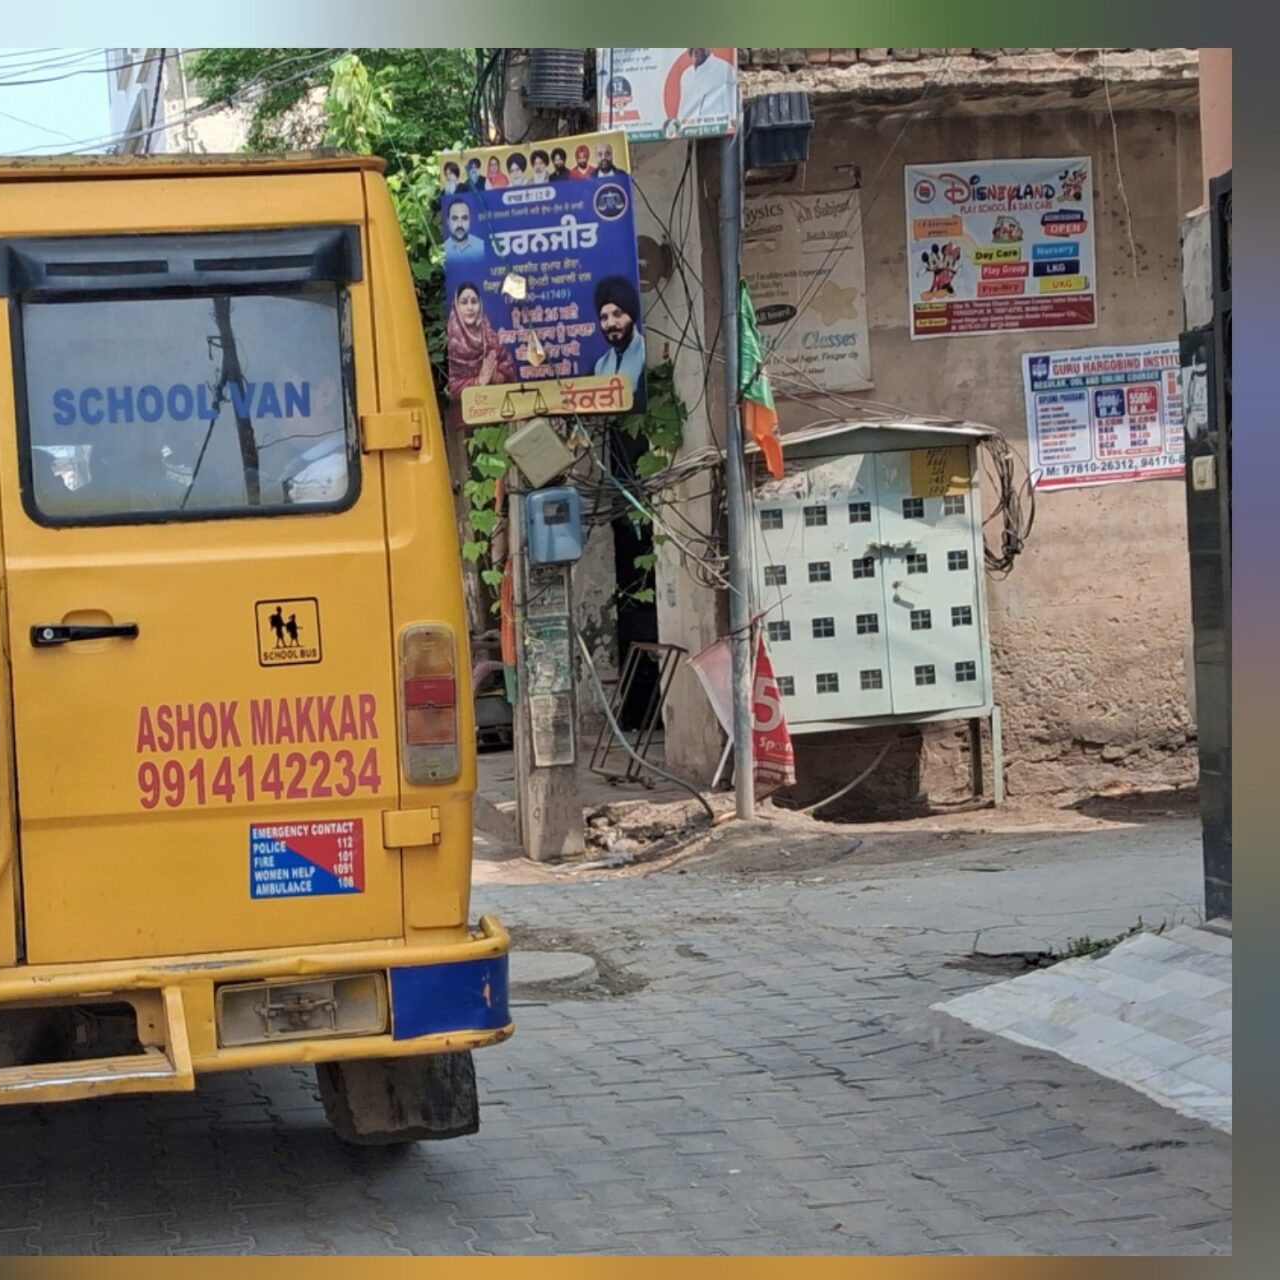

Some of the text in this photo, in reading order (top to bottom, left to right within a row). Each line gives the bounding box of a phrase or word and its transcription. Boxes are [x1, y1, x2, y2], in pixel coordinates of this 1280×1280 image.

[1050, 224, 1081, 234] OPEN
[975, 249, 1018, 261] Day Care
[983, 264, 1027, 277] Play Group
[1046, 263, 1065, 272] LKG
[1052, 363, 1081, 376] GURU
[52, 381, 311, 426] SCHOOL VAN
[263, 647, 317, 661] SCHOOL BUS
[136, 693, 379, 753] ASHOK MAKKAR
[137, 747, 381, 809] 9914142234
[252, 821, 354, 840] EMERGENCY CONTACT
[253, 836, 353, 854] POLICE 112
[254, 850, 353, 868] FIRE 101
[254, 863, 353, 882] WOMEN HELP 1091
[256, 880, 312, 896] AMBULANCE
